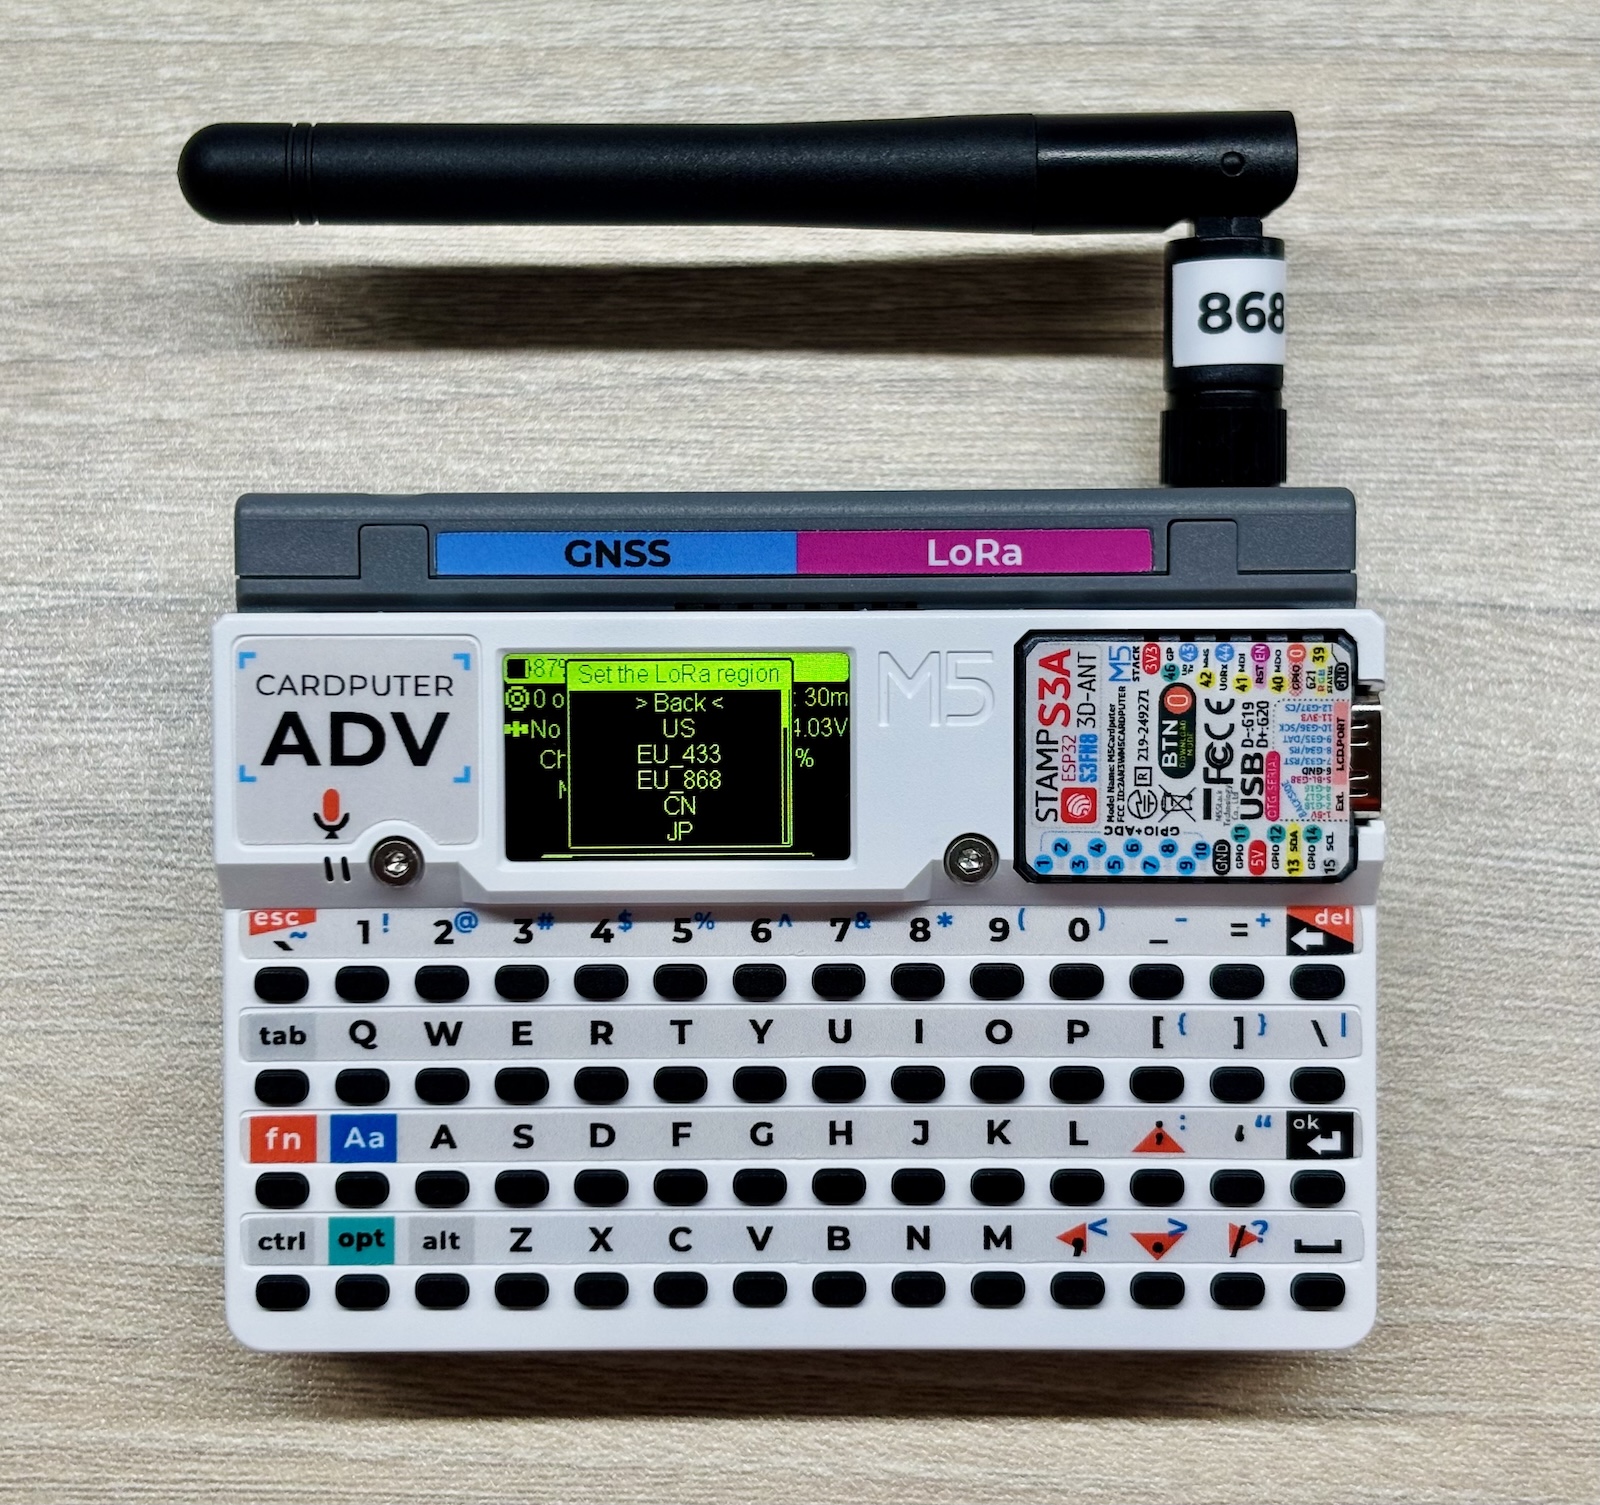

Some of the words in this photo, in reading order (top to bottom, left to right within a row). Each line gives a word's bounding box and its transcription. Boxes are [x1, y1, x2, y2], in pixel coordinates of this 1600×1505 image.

[1197, 291, 1284, 334] 868
[564, 540, 670, 567] GNSS
[929, 539, 1021, 565] LoRa
[1145, 646, 1158, 670] 3V3
[1182, 644, 1194, 660] 43
[1220, 644, 1230, 660] 44
[1255, 645, 1266, 661] EN
[1291, 649, 1302, 658] 0
[1312, 647, 1324, 663] 39
[1108, 645, 1132, 682] M5
[1132, 645, 1140, 682] STACK
[1164, 664, 1176, 680] 46
[578, 665, 612, 683] Set
[618, 665, 649, 683] the
[655, 665, 710, 683] LoRa
[717, 666, 780, 687] region
[1201, 671, 1212, 688] 42
[1256, 664, 1264, 684] RST
[1272, 676, 1284, 692] 40
[1292, 664, 1300, 690] GPIO
[1306, 670, 1316, 690] G21
[1336, 664, 1346, 689] GND
[257, 675, 453, 696] CARDPUTER
[878, 650, 994, 727] M5
[1038, 648, 1070, 728] S3A
[1076, 651, 1096, 729] 3D-ANT
[1236, 677, 1247, 692] 41
[533, 689, 546, 708] 0
[654, 693, 707, 712] Back
[804, 687, 849, 706] 30m
[1166, 694, 1188, 706] 0
[530, 720, 561, 739] No
[662, 719, 696, 738] US
[1107, 703, 1116, 762] M5Cardputer
[1137, 688, 1149, 761] 219-249271
[1256, 700, 1269, 748] D+:G20
[261, 711, 449, 766] ADV
[1162, 719, 1178, 768] BTN
[637, 744, 721, 768] EU_433
[1062, 735, 1076, 782] ESP32
[1079, 734, 1098, 782] S3FN8
[1035, 729, 1058, 822] STAMP
[1107, 764, 1115, 793] Name:
[1268, 756, 1277, 791] SERIAL
[1301, 767, 1332, 775] 6-GND
[637, 770, 721, 794] EU_868
[1240, 752, 1264, 820] USB
[664, 796, 696, 815] CN
[1106, 796, 1115, 823] Model
[1268, 795, 1277, 818] OTG
[1336, 791, 1344, 812] Ext.
[1117, 805, 1125, 823] FCC
[667, 822, 694, 841] JP
[1104, 825, 1180, 836] GPIO+ADC
[1234, 826, 1246, 841] 11
[1270, 826, 1282, 841] 12
[1306, 827, 1318, 842] 14
[1054, 842, 1067, 852] 2
[1090, 844, 1103, 853] 4
[1126, 843, 1139, 853] 6
[1162, 844, 1175, 854] 8
[1195, 842, 1207, 856] 10
[1289, 830, 1298, 852] SDA
[1326, 832, 1334, 851] SCL
[1072, 860, 1085, 869] 3
[1107, 860, 1121, 869] 5
[1143, 860, 1156, 870] 7
[1179, 861, 1192, 870] 9
[1216, 844, 1227, 872] GND
[1236, 844, 1244, 869] GPIO
[1251, 849, 1264, 867] 5V
[1272, 844, 1280, 870] GPIO
[1287, 859, 1300, 874] 13
[1308, 844, 1316, 870] GPIO
[1324, 859, 1336, 874] 15
[254, 910, 299, 926] esc
[358, 921, 369, 944] 1
[434, 920, 453, 944] 2
[514, 918, 533, 943] 3
[590, 918, 614, 943] 4
[672, 918, 693, 943] 5
[750, 918, 772, 943] 6
[830, 918, 851, 942] 7
[910, 918, 930, 942] 8
[989, 918, 1009, 941] 9
[1069, 918, 1089, 941] 0
[1316, 909, 1349, 924] del
[259, 1025, 306, 1045] tab
[349, 1020, 378, 1049] Q
[424, 1021, 463, 1046] W
[512, 1021, 533, 1046] E
[591, 1021, 613, 1045] R
[670, 1020, 692, 1044] T
[749, 1019, 773, 1044] Y
[829, 1019, 852, 1044] U
[915, 1019, 923, 1043] I
[985, 1019, 1013, 1044] O
[1067, 1020, 1090, 1044] P
[265, 1127, 302, 1150] fn
[344, 1127, 386, 1150] Aa
[430, 1124, 457, 1149] A
[513, 1124, 534, 1149] S
[590, 1123, 615, 1147] D
[672, 1122, 692, 1147] F
[750, 1122, 773, 1146] G
[829, 1121, 852, 1145] H
[911, 1120, 929, 1145] J
[987, 1120, 1011, 1145] K
[1069, 1121, 1089, 1146] L
[1294, 1115, 1318, 1129] ok
[258, 1231, 305, 1250] ctrl
[339, 1230, 384, 1251] opt
[423, 1231, 460, 1250] alt
[510, 1228, 532, 1252] Z
[589, 1227, 613, 1252] X
[669, 1227, 692, 1252] C
[747, 1226, 773, 1251] V
[828, 1226, 850, 1251] B
[907, 1226, 930, 1250] N
[984, 1225, 1012, 1250] M
